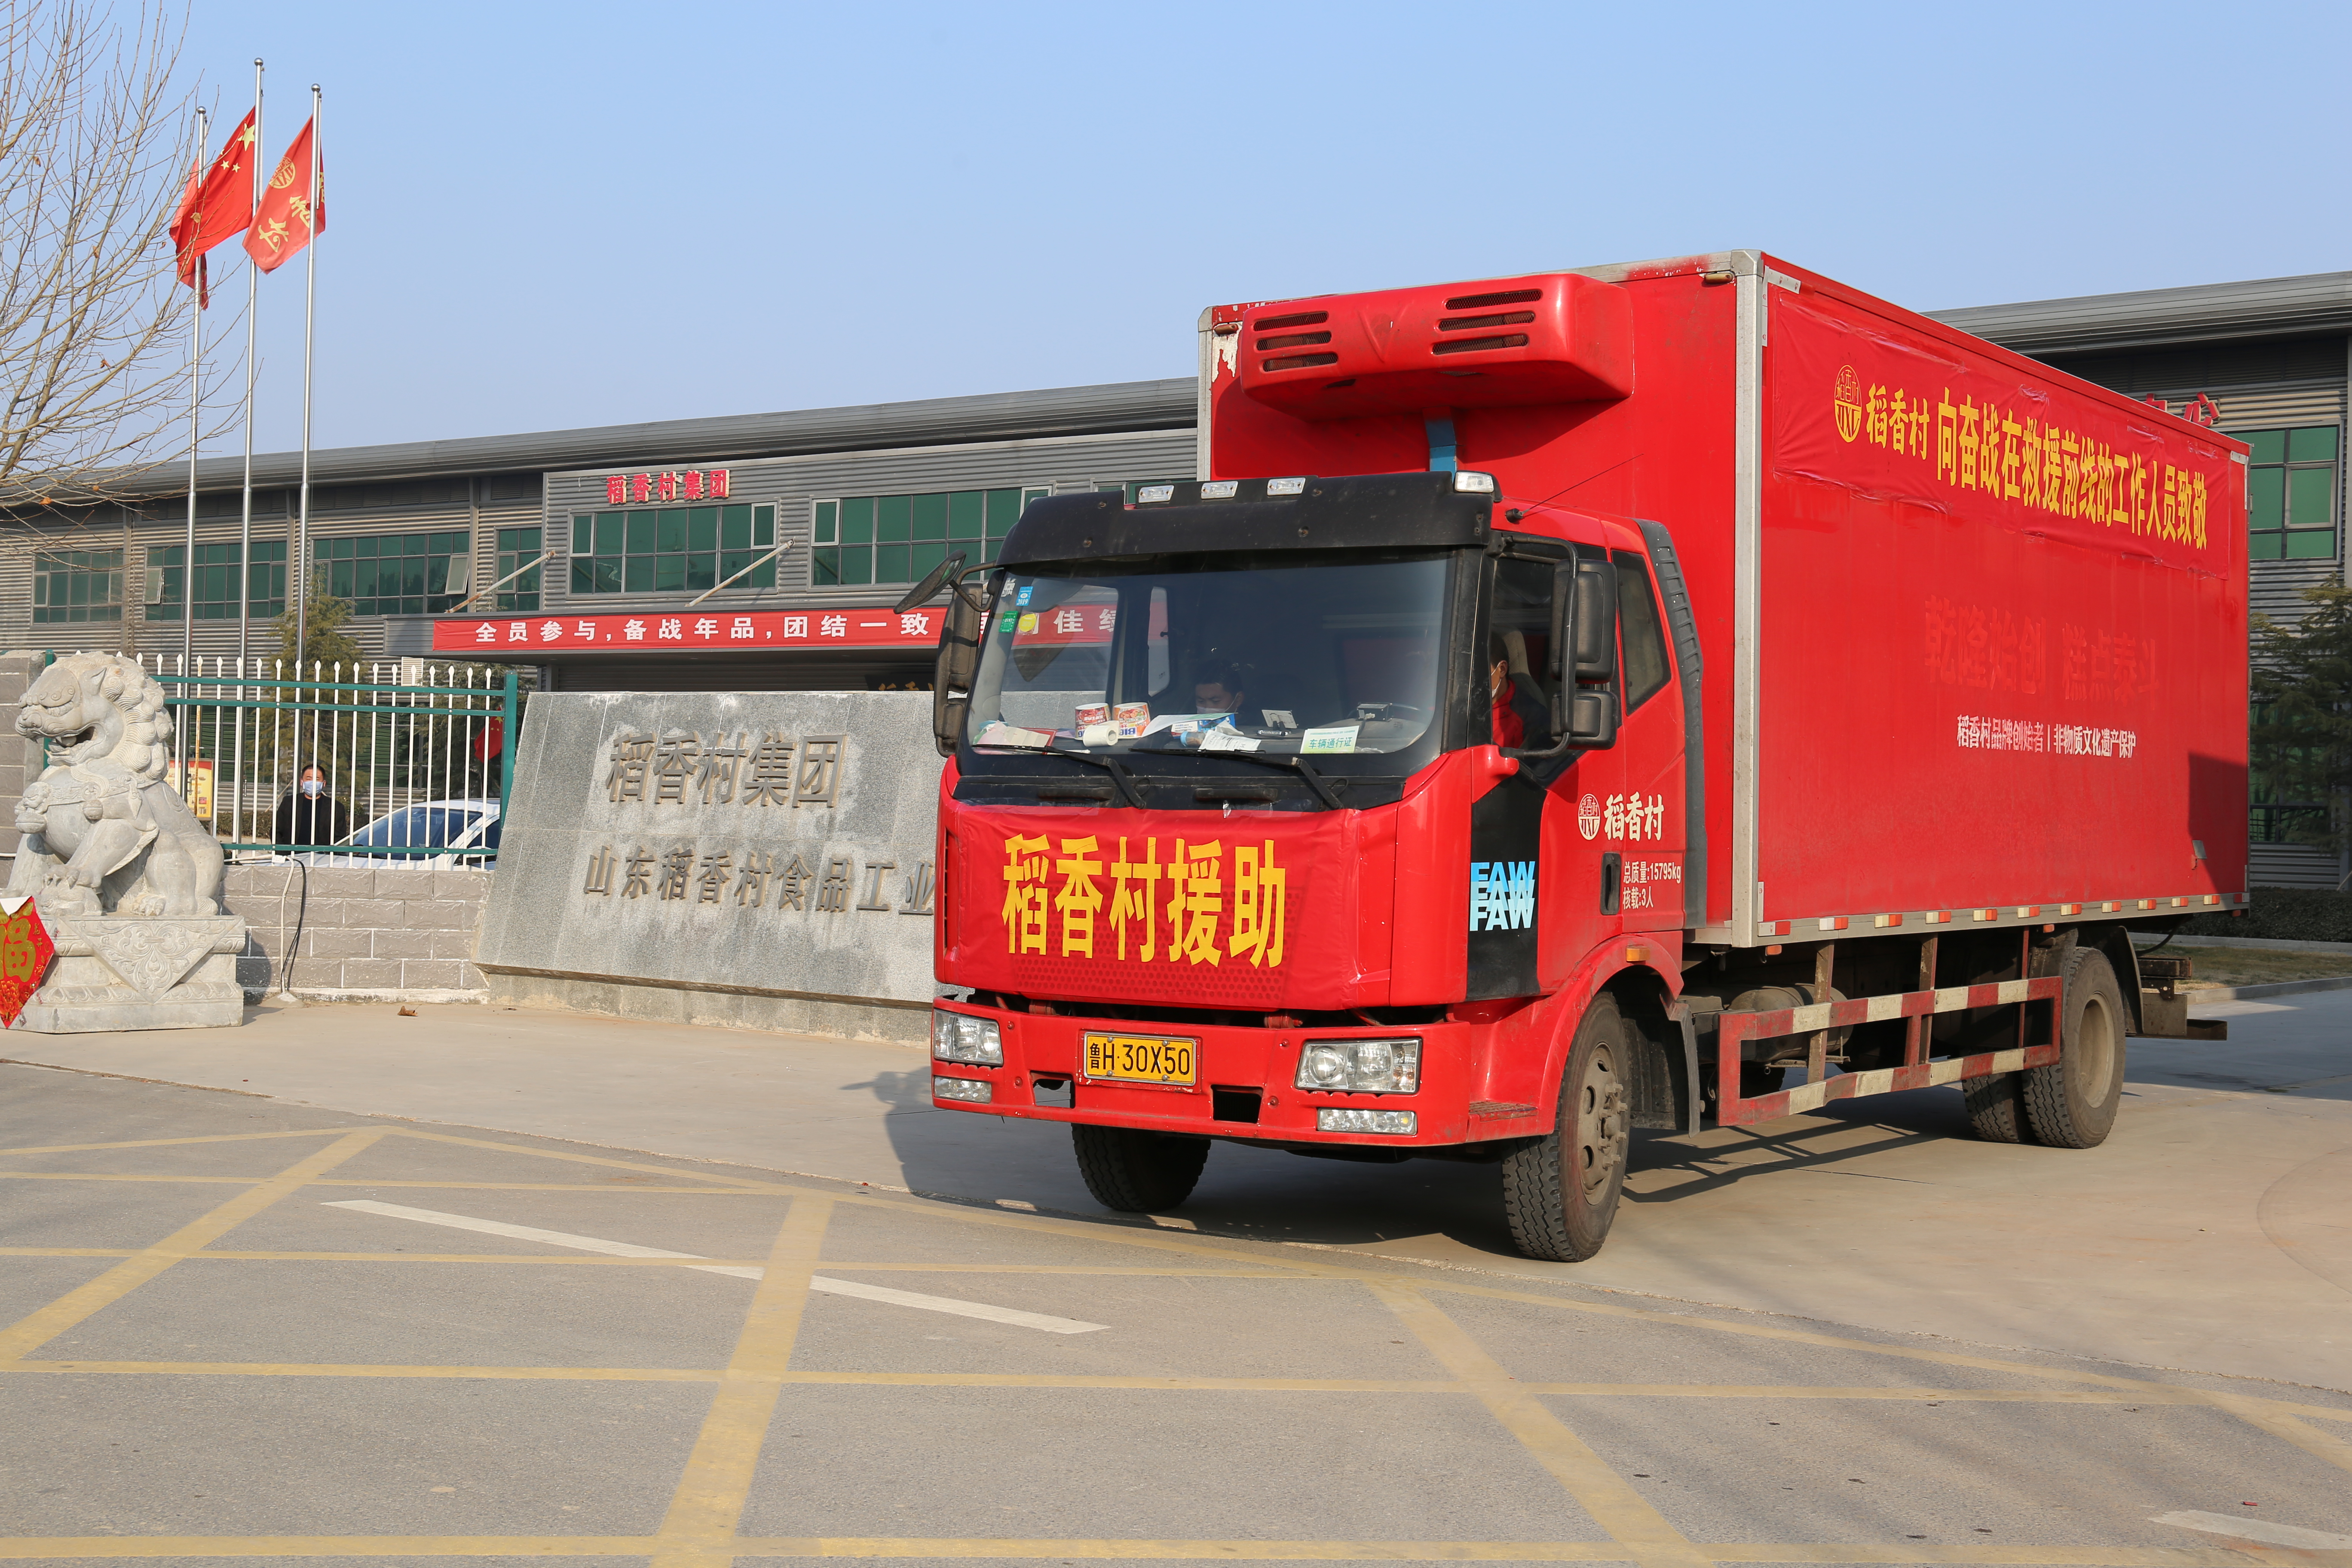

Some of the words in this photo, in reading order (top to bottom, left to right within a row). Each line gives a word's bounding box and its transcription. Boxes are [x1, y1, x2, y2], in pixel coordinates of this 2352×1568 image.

[606, 469, 730, 504] 稻香村集团
[1866, 383, 1930, 460] 稻香村
[1937, 387, 2208, 550] 向奋战在救援前线的工作人员致敬
[1925, 594, 2046, 695] 乾隆始创
[2062, 623, 2160, 710] 糕点泰斗
[1308, 737, 1353, 749] 车辆通行证
[606, 732, 846, 807] 稻香村集团
[1603, 791, 1665, 841] 稻香村
[1623, 861, 1681, 884] 总质量:15795kg
[1002, 833, 1286, 968] 稻香村援助
[1623, 886, 1654, 910] 核载:3人
[1090, 1042, 1190, 1075] 鲁H·30X50
